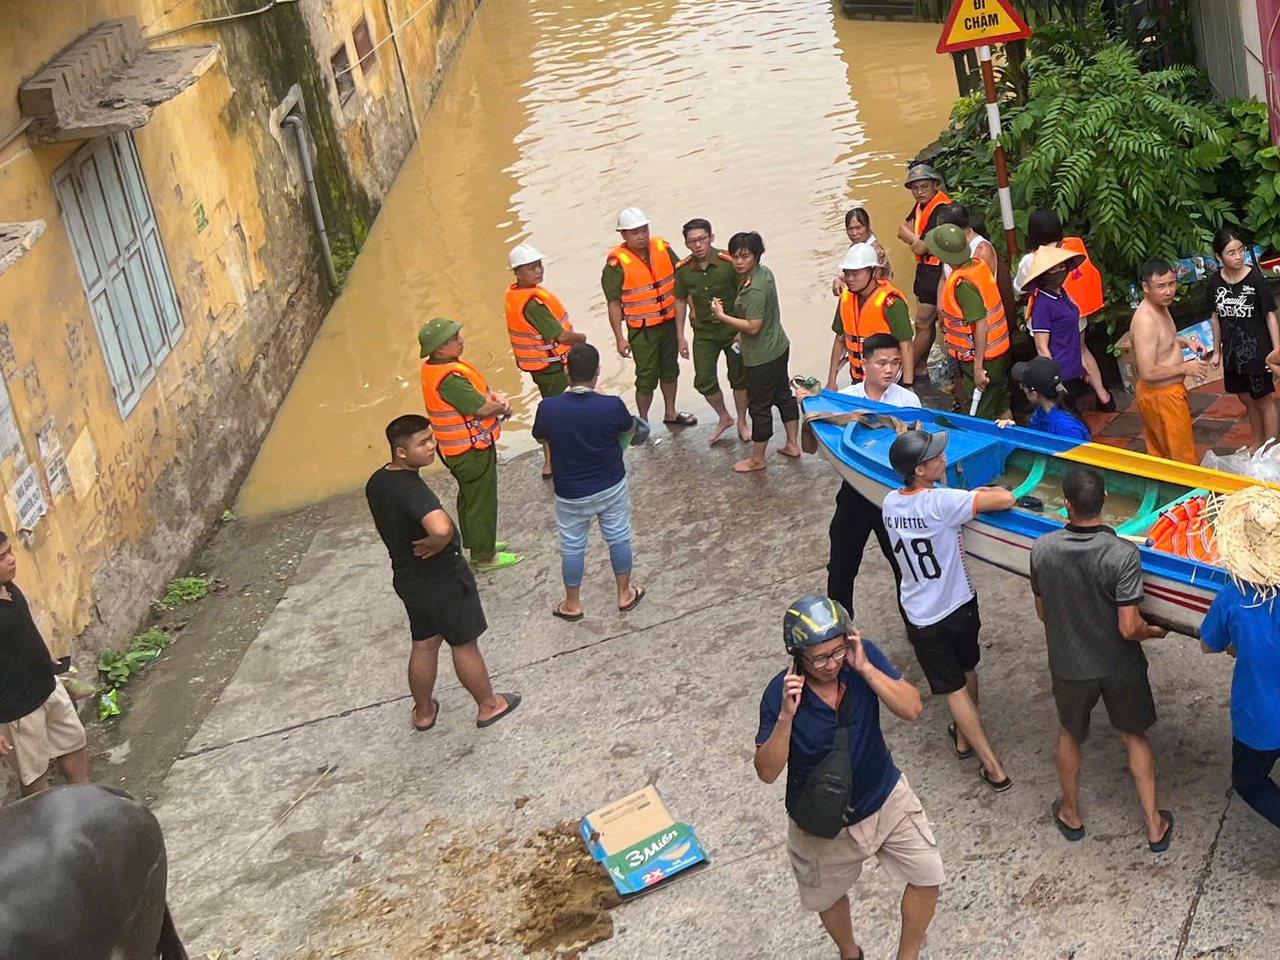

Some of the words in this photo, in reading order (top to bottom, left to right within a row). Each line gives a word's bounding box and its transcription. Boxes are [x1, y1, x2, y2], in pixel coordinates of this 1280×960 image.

[1215, 286, 1253, 307] Beauty
[1217, 304, 1254, 318] BEAST
[894, 517, 929, 529] VIETTEL
[893, 538, 942, 582] 18
